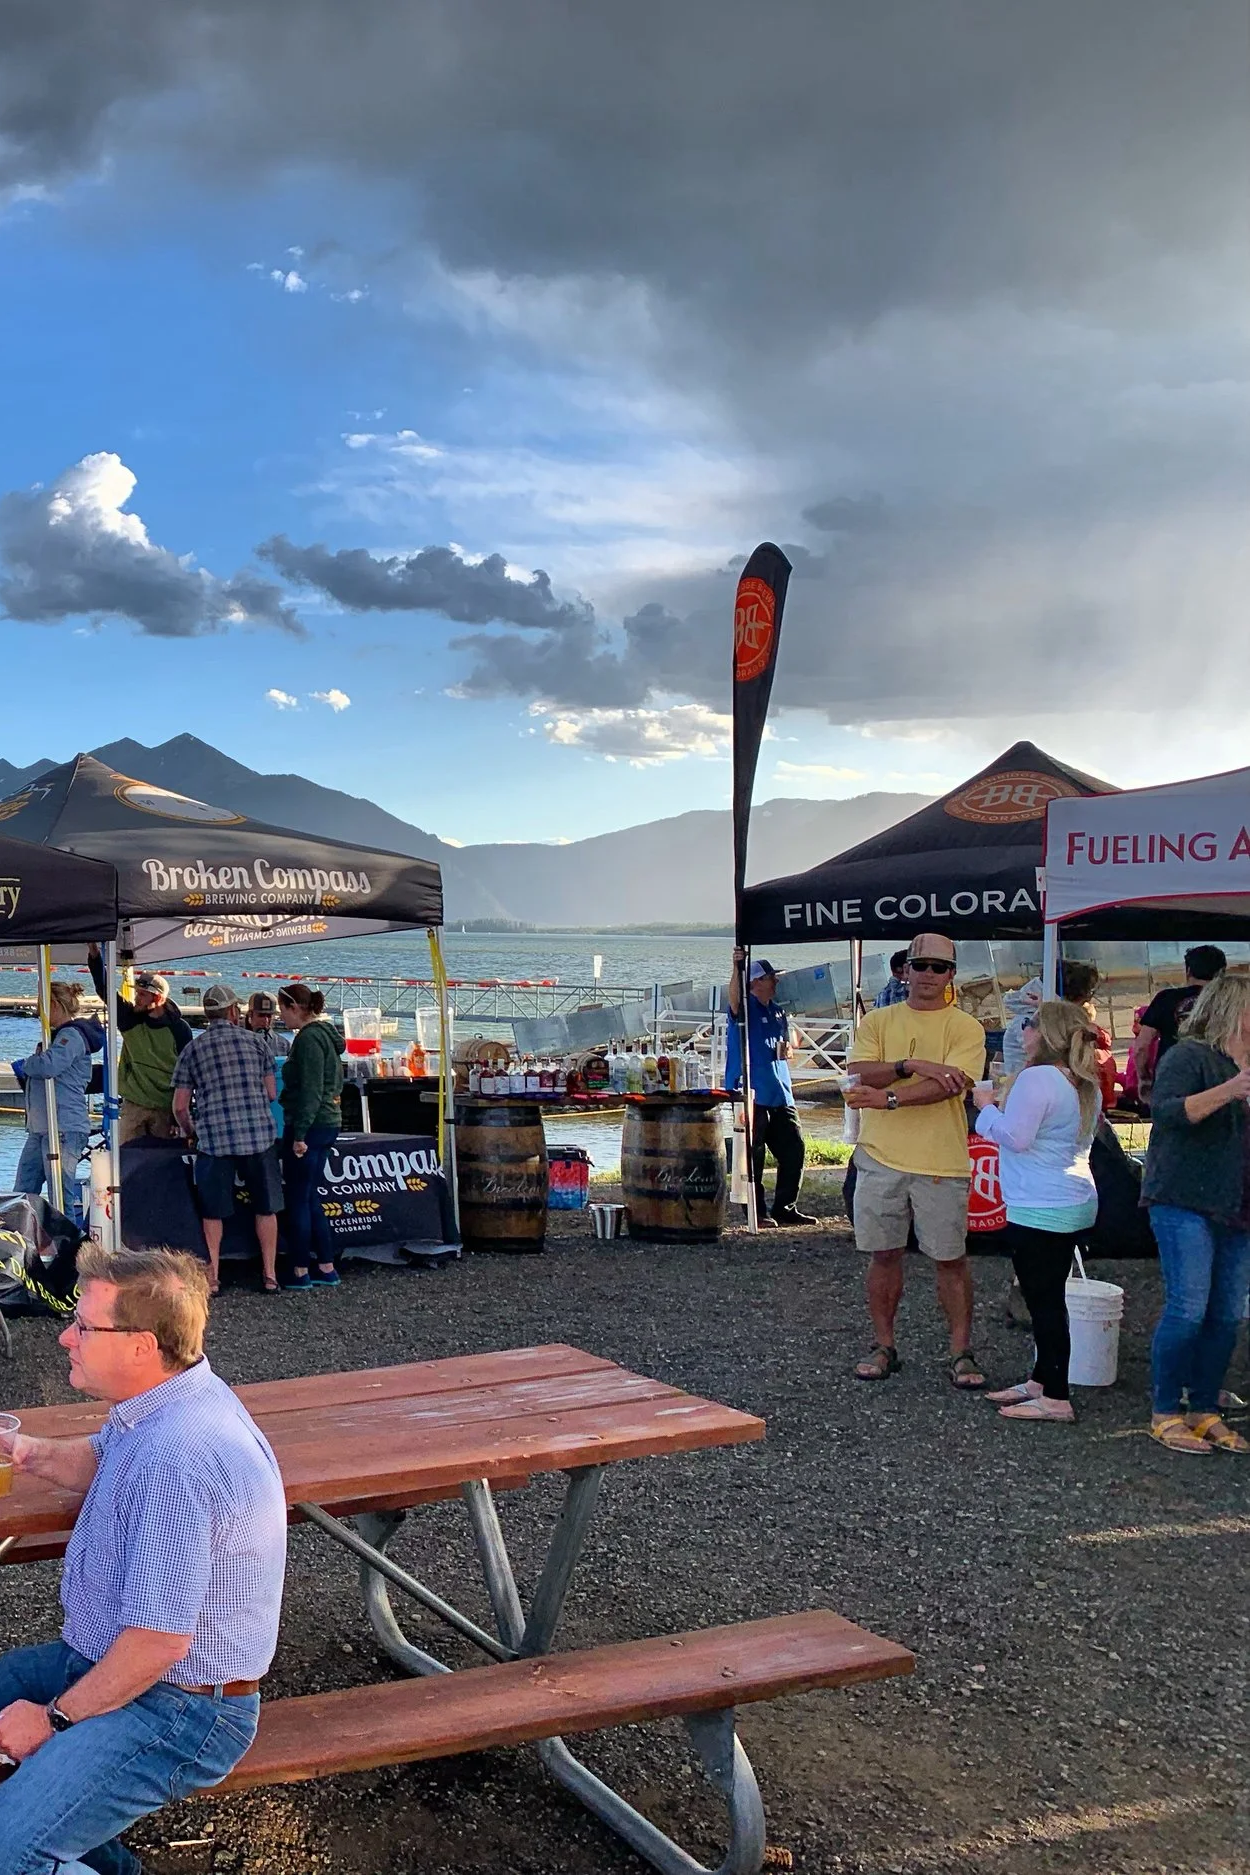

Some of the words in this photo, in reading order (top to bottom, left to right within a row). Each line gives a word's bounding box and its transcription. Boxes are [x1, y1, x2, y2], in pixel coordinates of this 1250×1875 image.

[964, 811, 1041, 821] COLORADO
[1067, 831, 1217, 866] FUELING
[142, 858, 252, 891] Broken
[254, 858, 372, 905] Compass
[205, 892, 257, 905] BREWING
[261, 893, 315, 905] COMPANY
[784, 898, 862, 928] FINE
[874, 888, 1043, 920] COLORA
[332, 1181, 397, 1195] COMPANY
[334, 1225, 371, 1233] COLORADO
